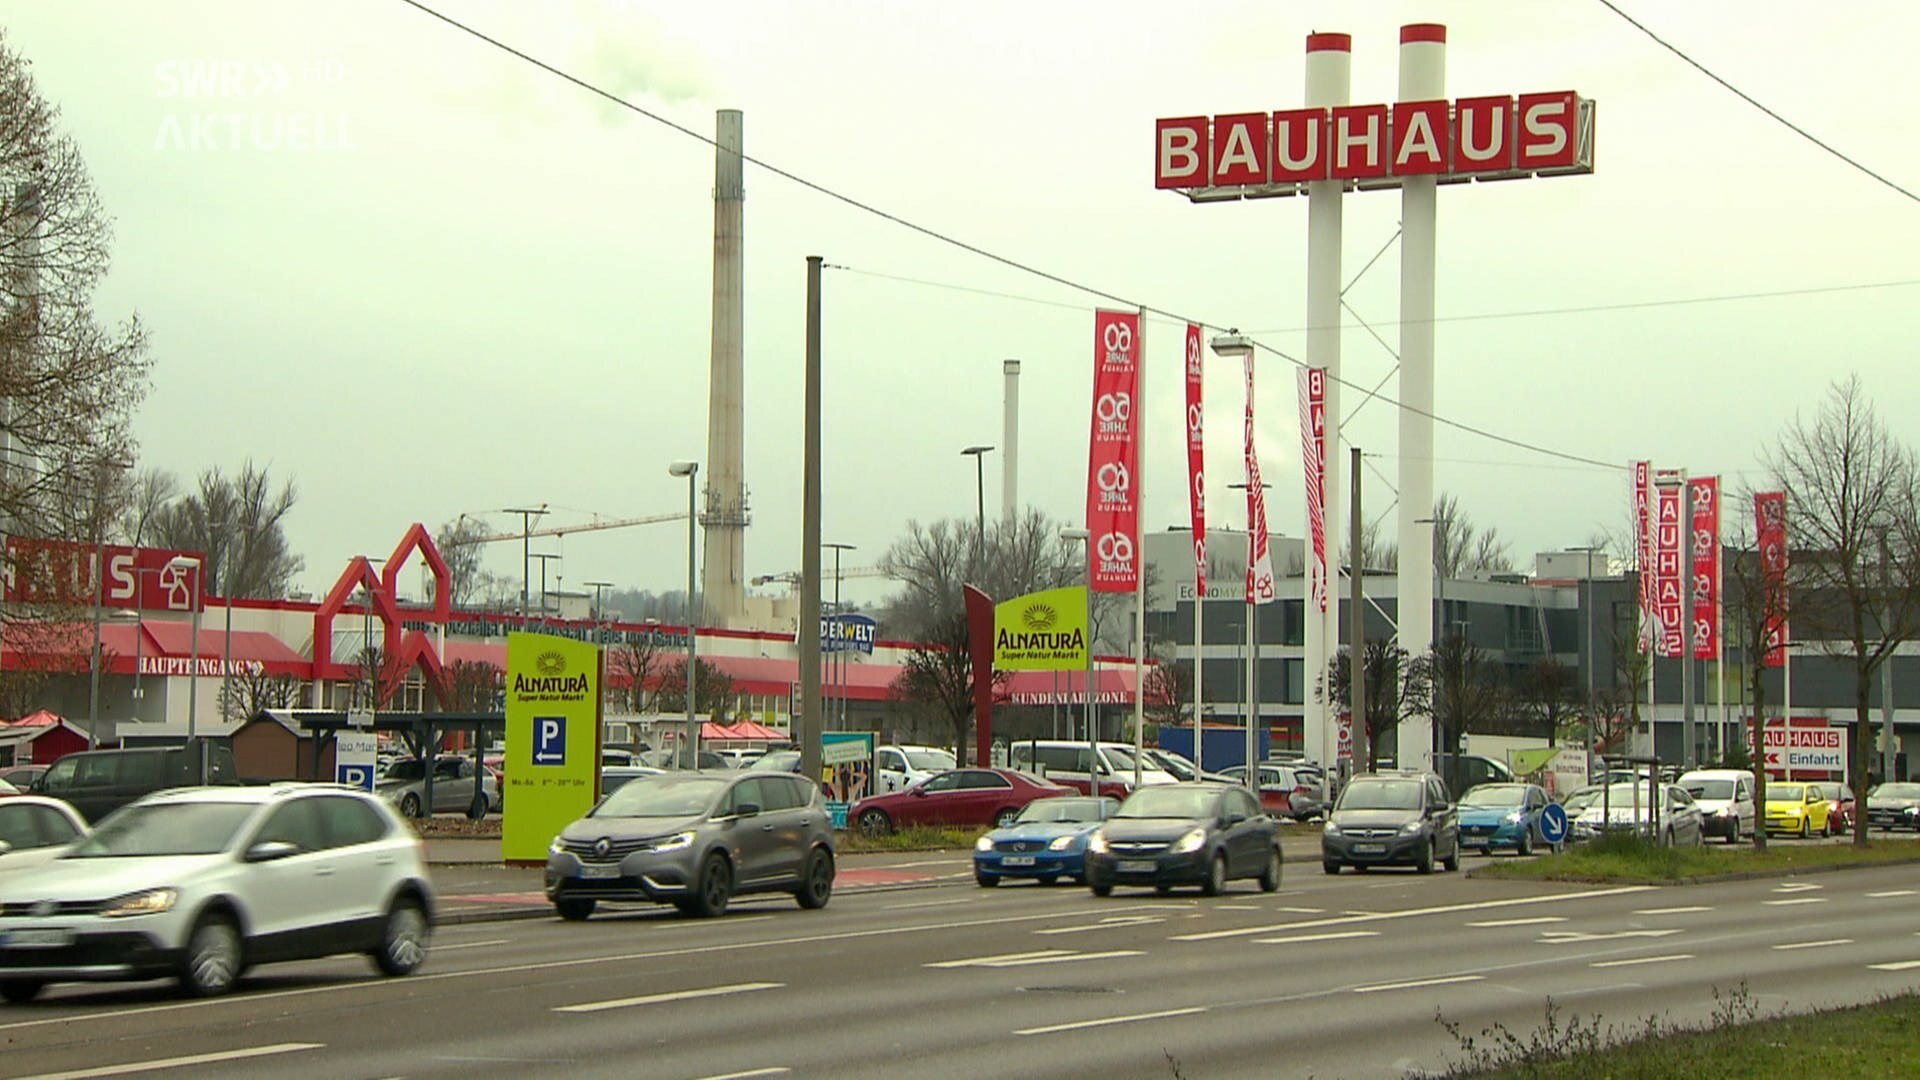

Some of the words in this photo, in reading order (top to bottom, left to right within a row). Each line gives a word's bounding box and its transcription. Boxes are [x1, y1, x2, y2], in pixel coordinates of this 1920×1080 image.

[1160, 101, 1566, 178] BAUHAUS
[820, 620, 875, 642] DERWELT
[997, 627, 1085, 650] ALNATURA
[1002, 651, 1025, 661] Super
[1027, 650, 1051, 660] Natur
[1053, 650, 1079, 660] Markt
[513, 672, 588, 693] ALNATURA
[541, 720, 559, 750] P
[1789, 752, 1841, 766] Einfahrt
